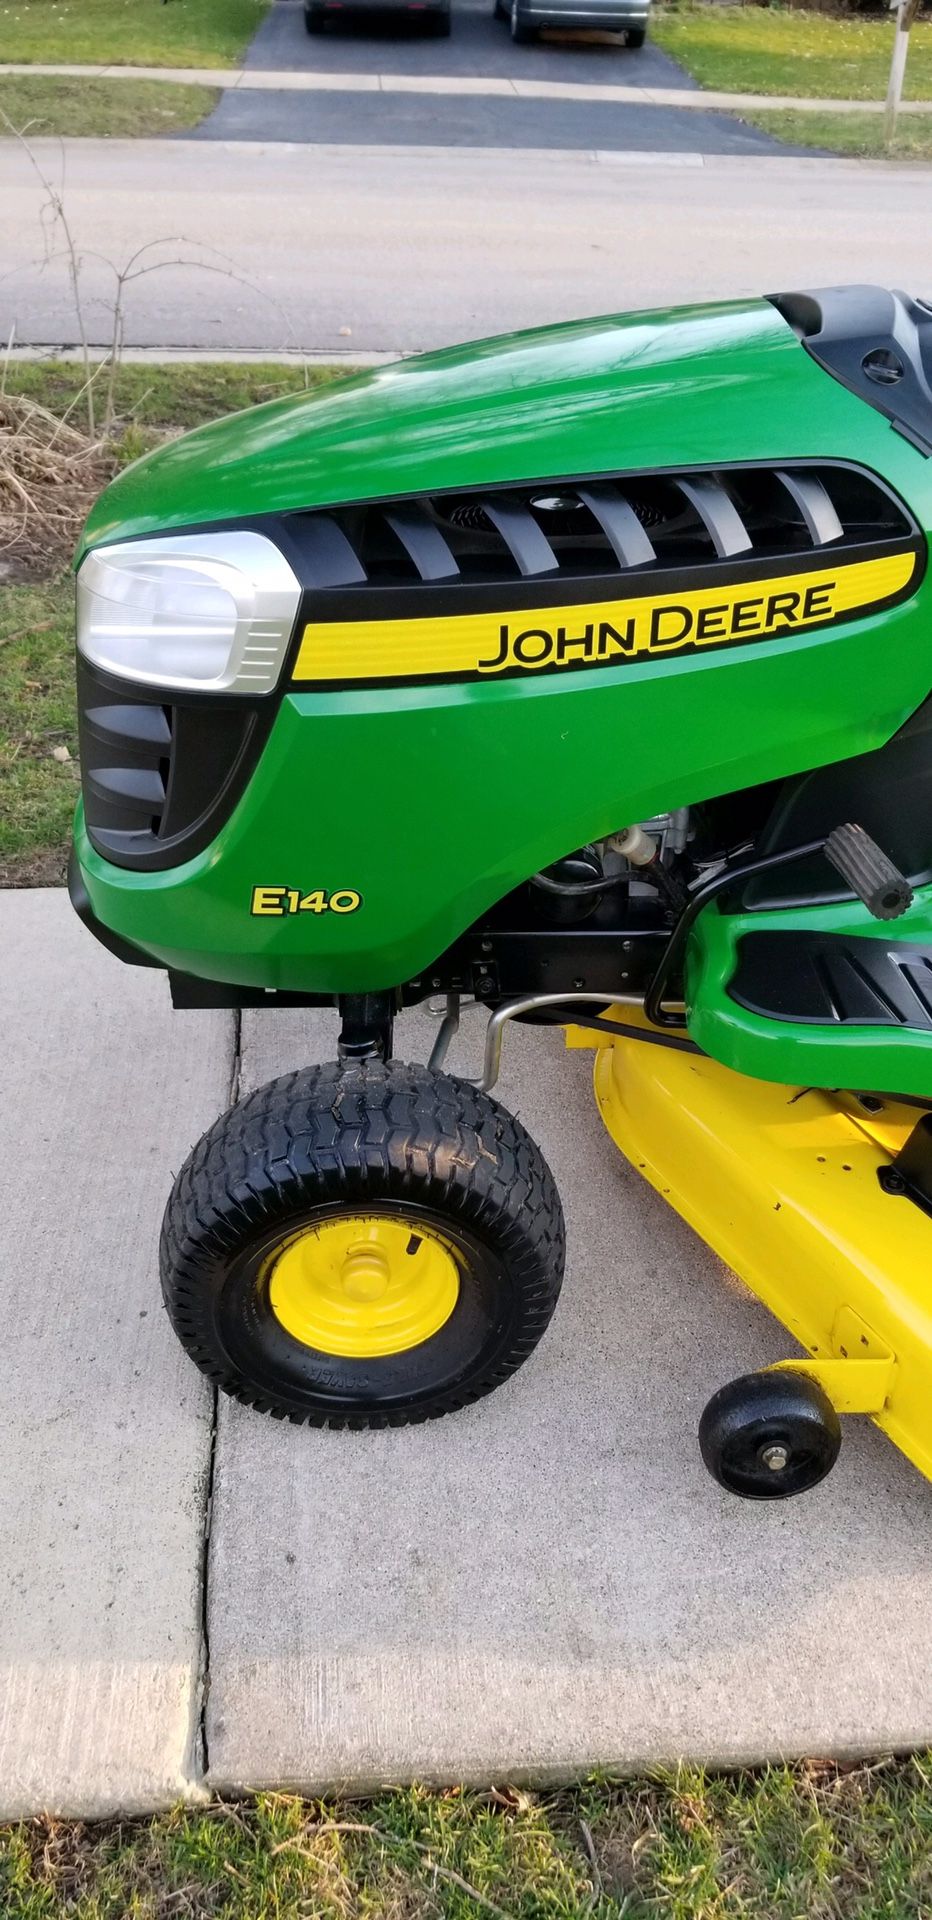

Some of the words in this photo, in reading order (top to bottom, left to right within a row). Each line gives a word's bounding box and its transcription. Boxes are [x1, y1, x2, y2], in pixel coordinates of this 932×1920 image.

[478, 617, 636, 668] JOHN
[649, 582, 836, 648] DEERE
[251, 887, 361, 915] E140
